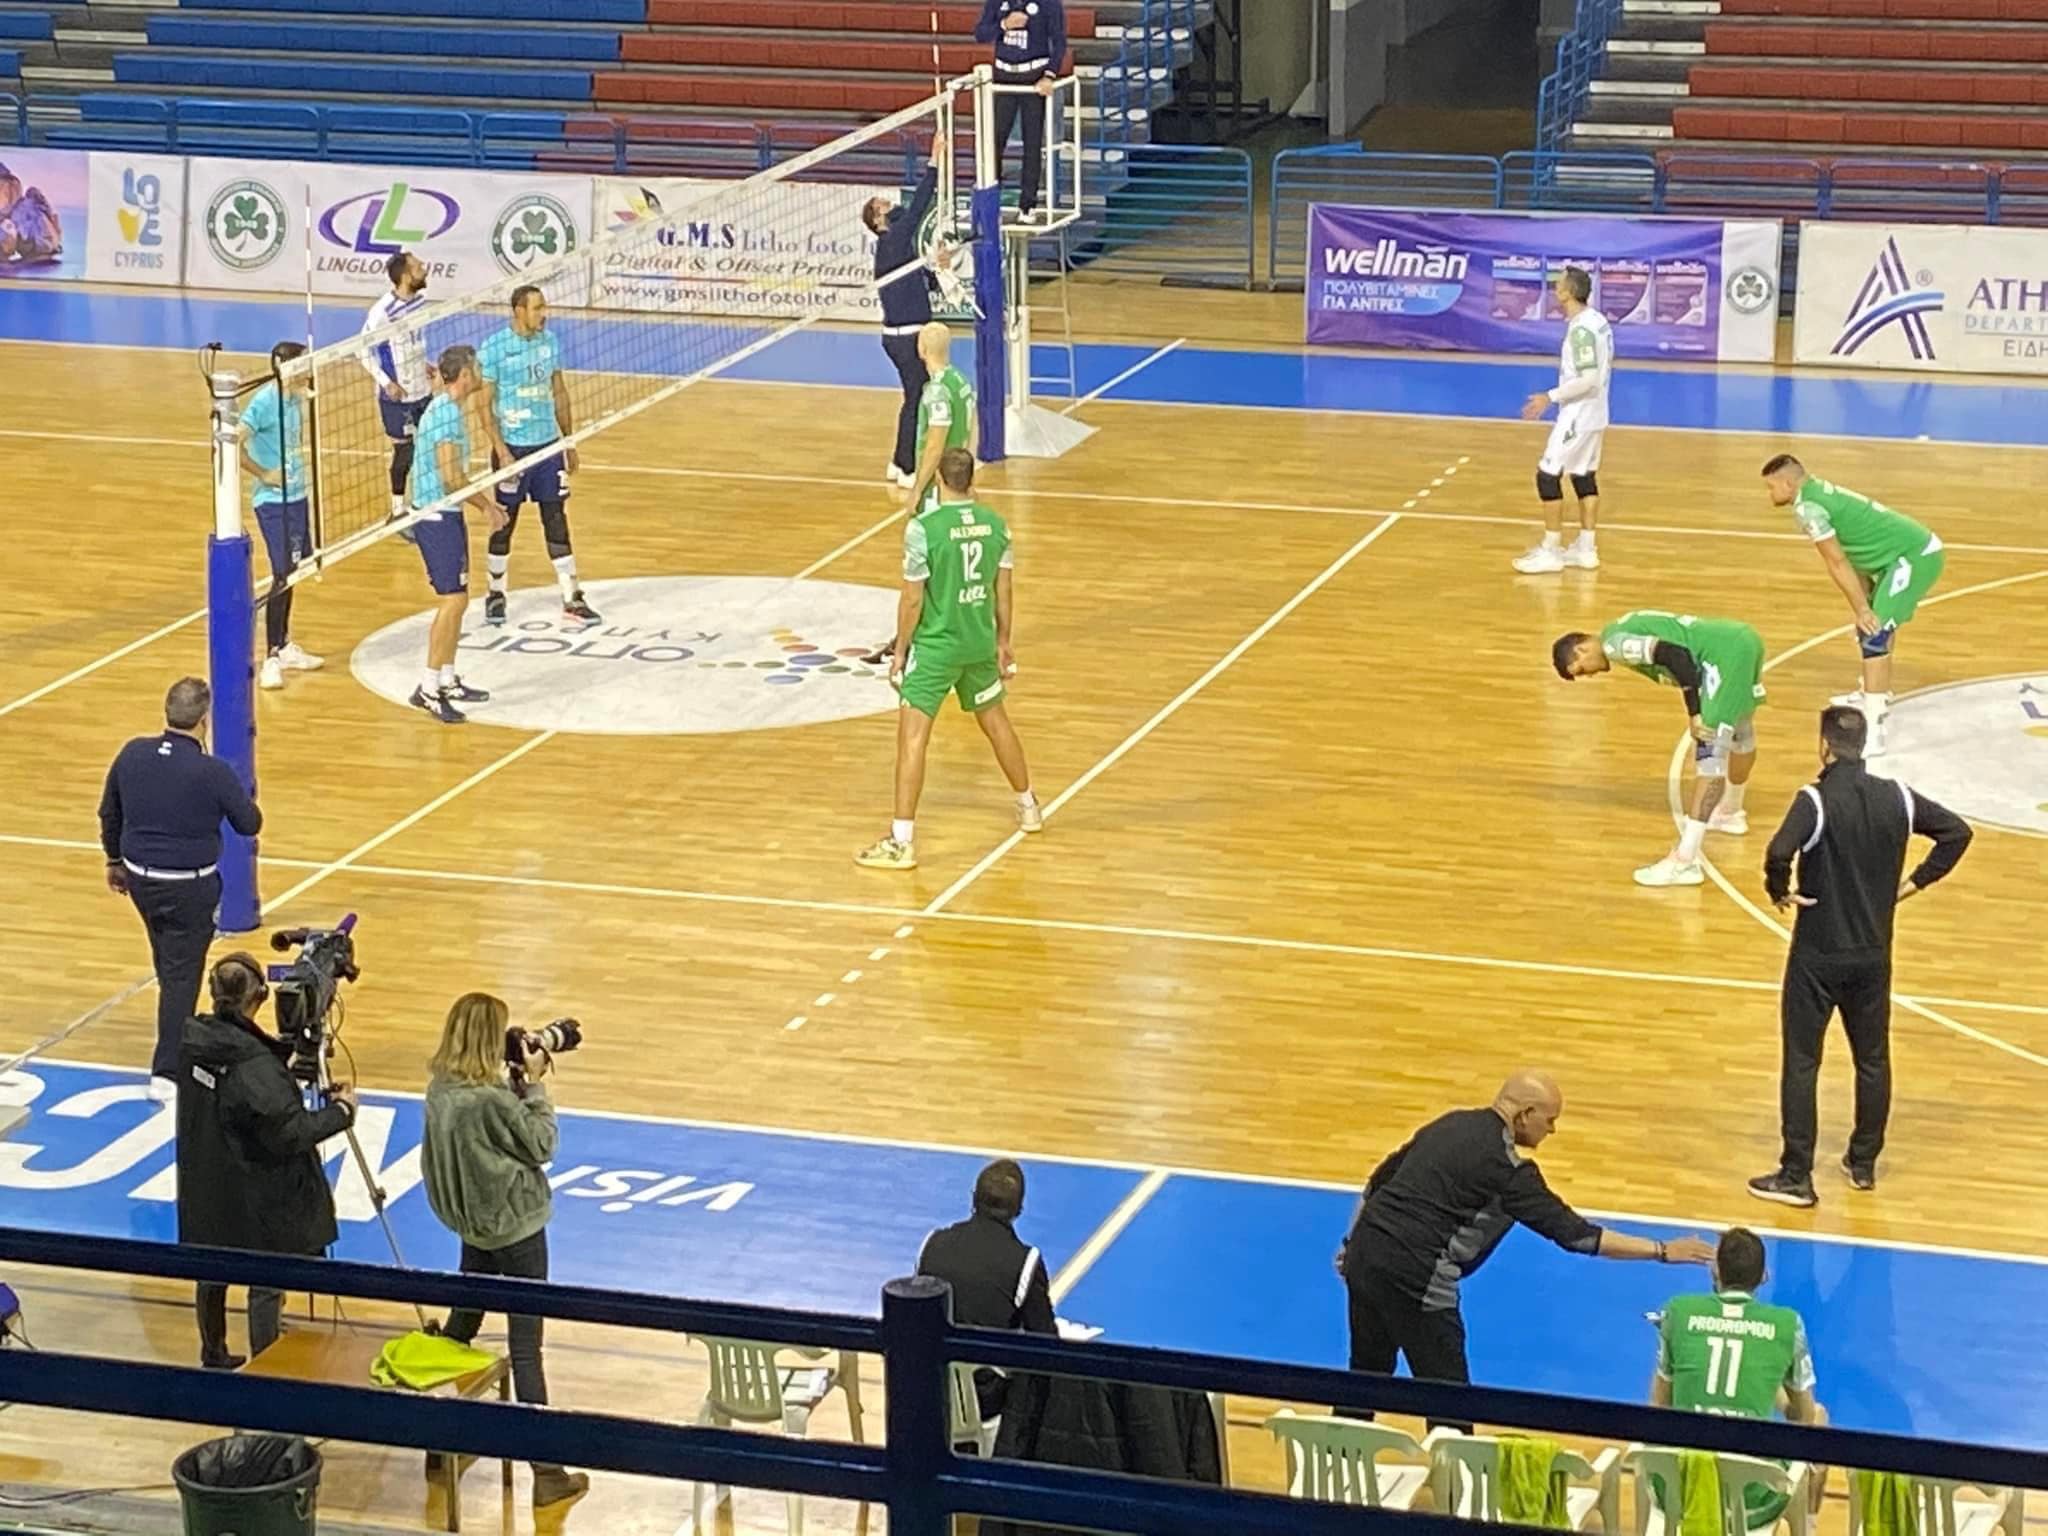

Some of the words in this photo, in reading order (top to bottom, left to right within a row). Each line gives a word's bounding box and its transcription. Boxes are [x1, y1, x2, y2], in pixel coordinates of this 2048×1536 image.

[114, 251, 164, 270] CYPRUS
[316, 256, 390, 276] LINGLO
[605, 251, 682, 272] Digital
[687, 257, 706, 273] &
[960, 541, 983, 582] 12
[541, 1161, 757, 1213] visi
[1687, 1314, 1776, 1341] PRODROMOU
[1705, 1335, 1744, 1398] 11
